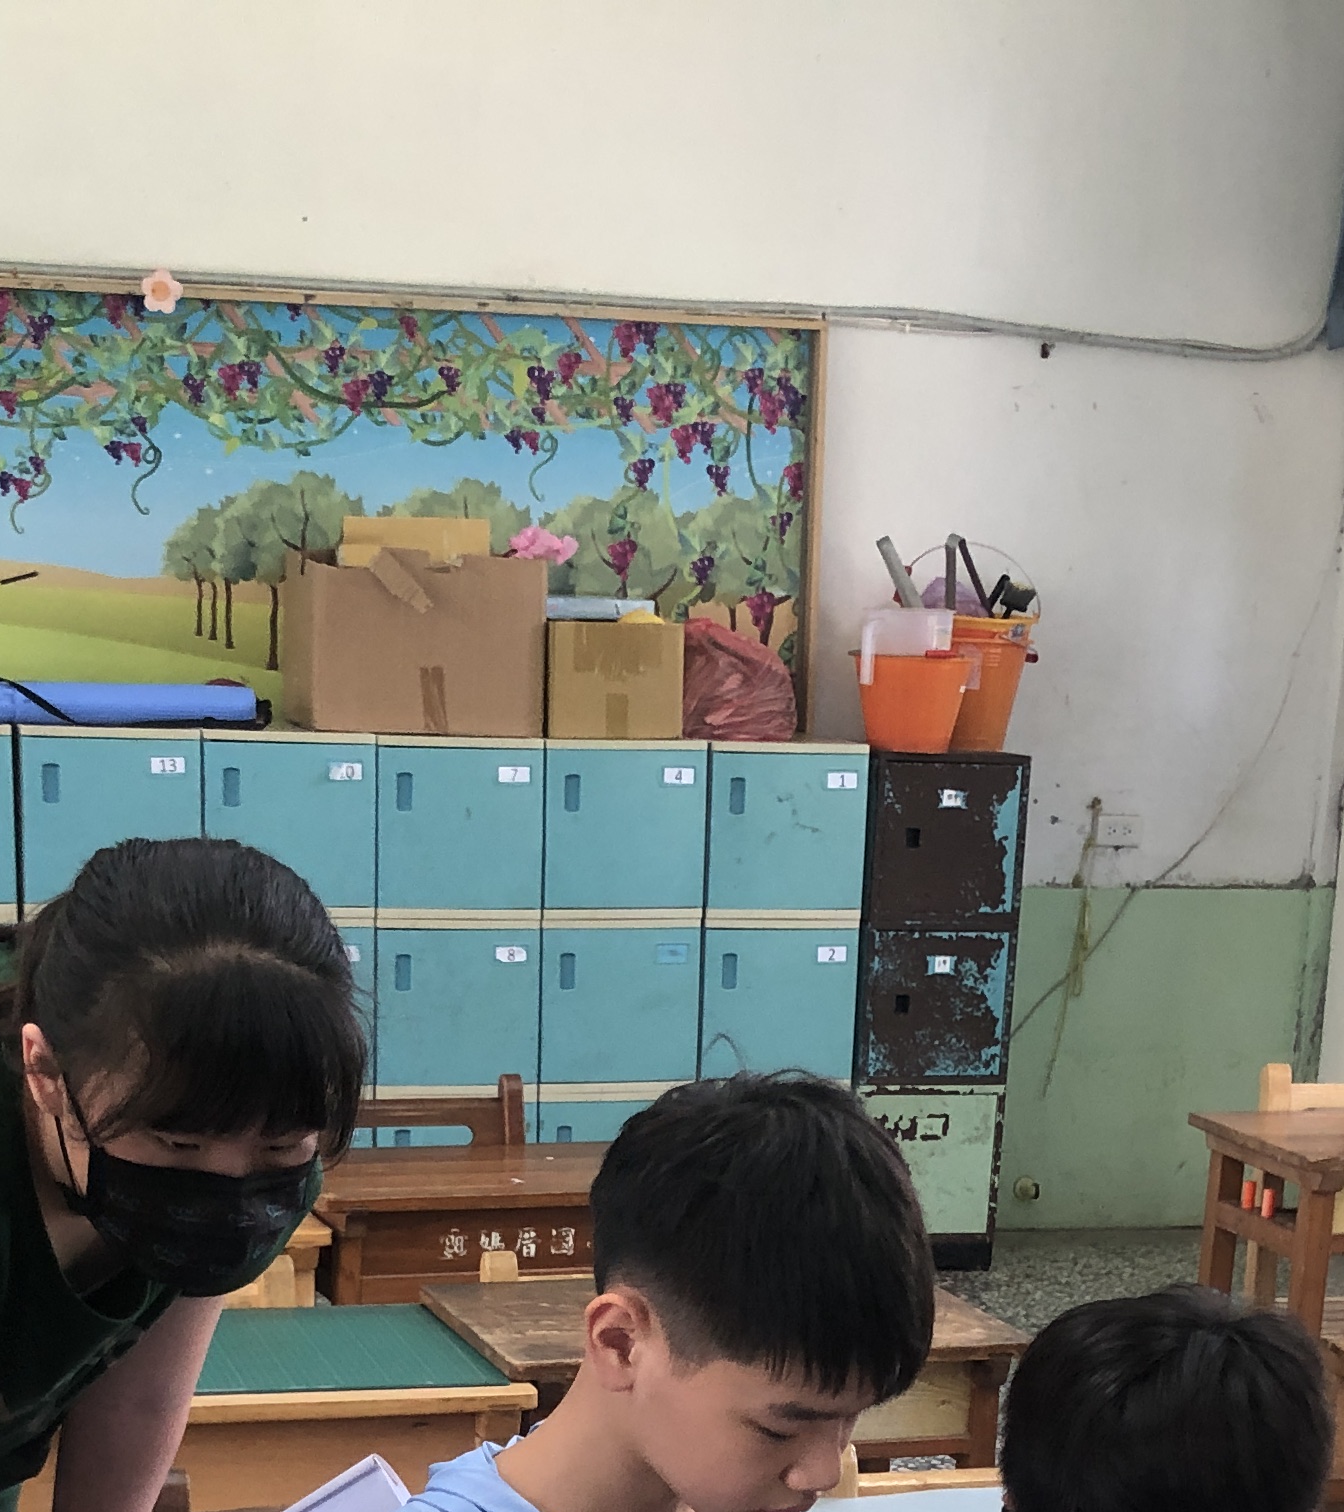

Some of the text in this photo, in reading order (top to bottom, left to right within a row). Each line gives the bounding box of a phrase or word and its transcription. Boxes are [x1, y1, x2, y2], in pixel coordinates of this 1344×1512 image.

[158, 758, 178, 773] 13
[510, 768, 519, 782] 7
[674, 769, 683, 784] 4
[838, 774, 847, 788] 1
[507, 948, 516, 962] 8
[828, 948, 836, 962] 2
